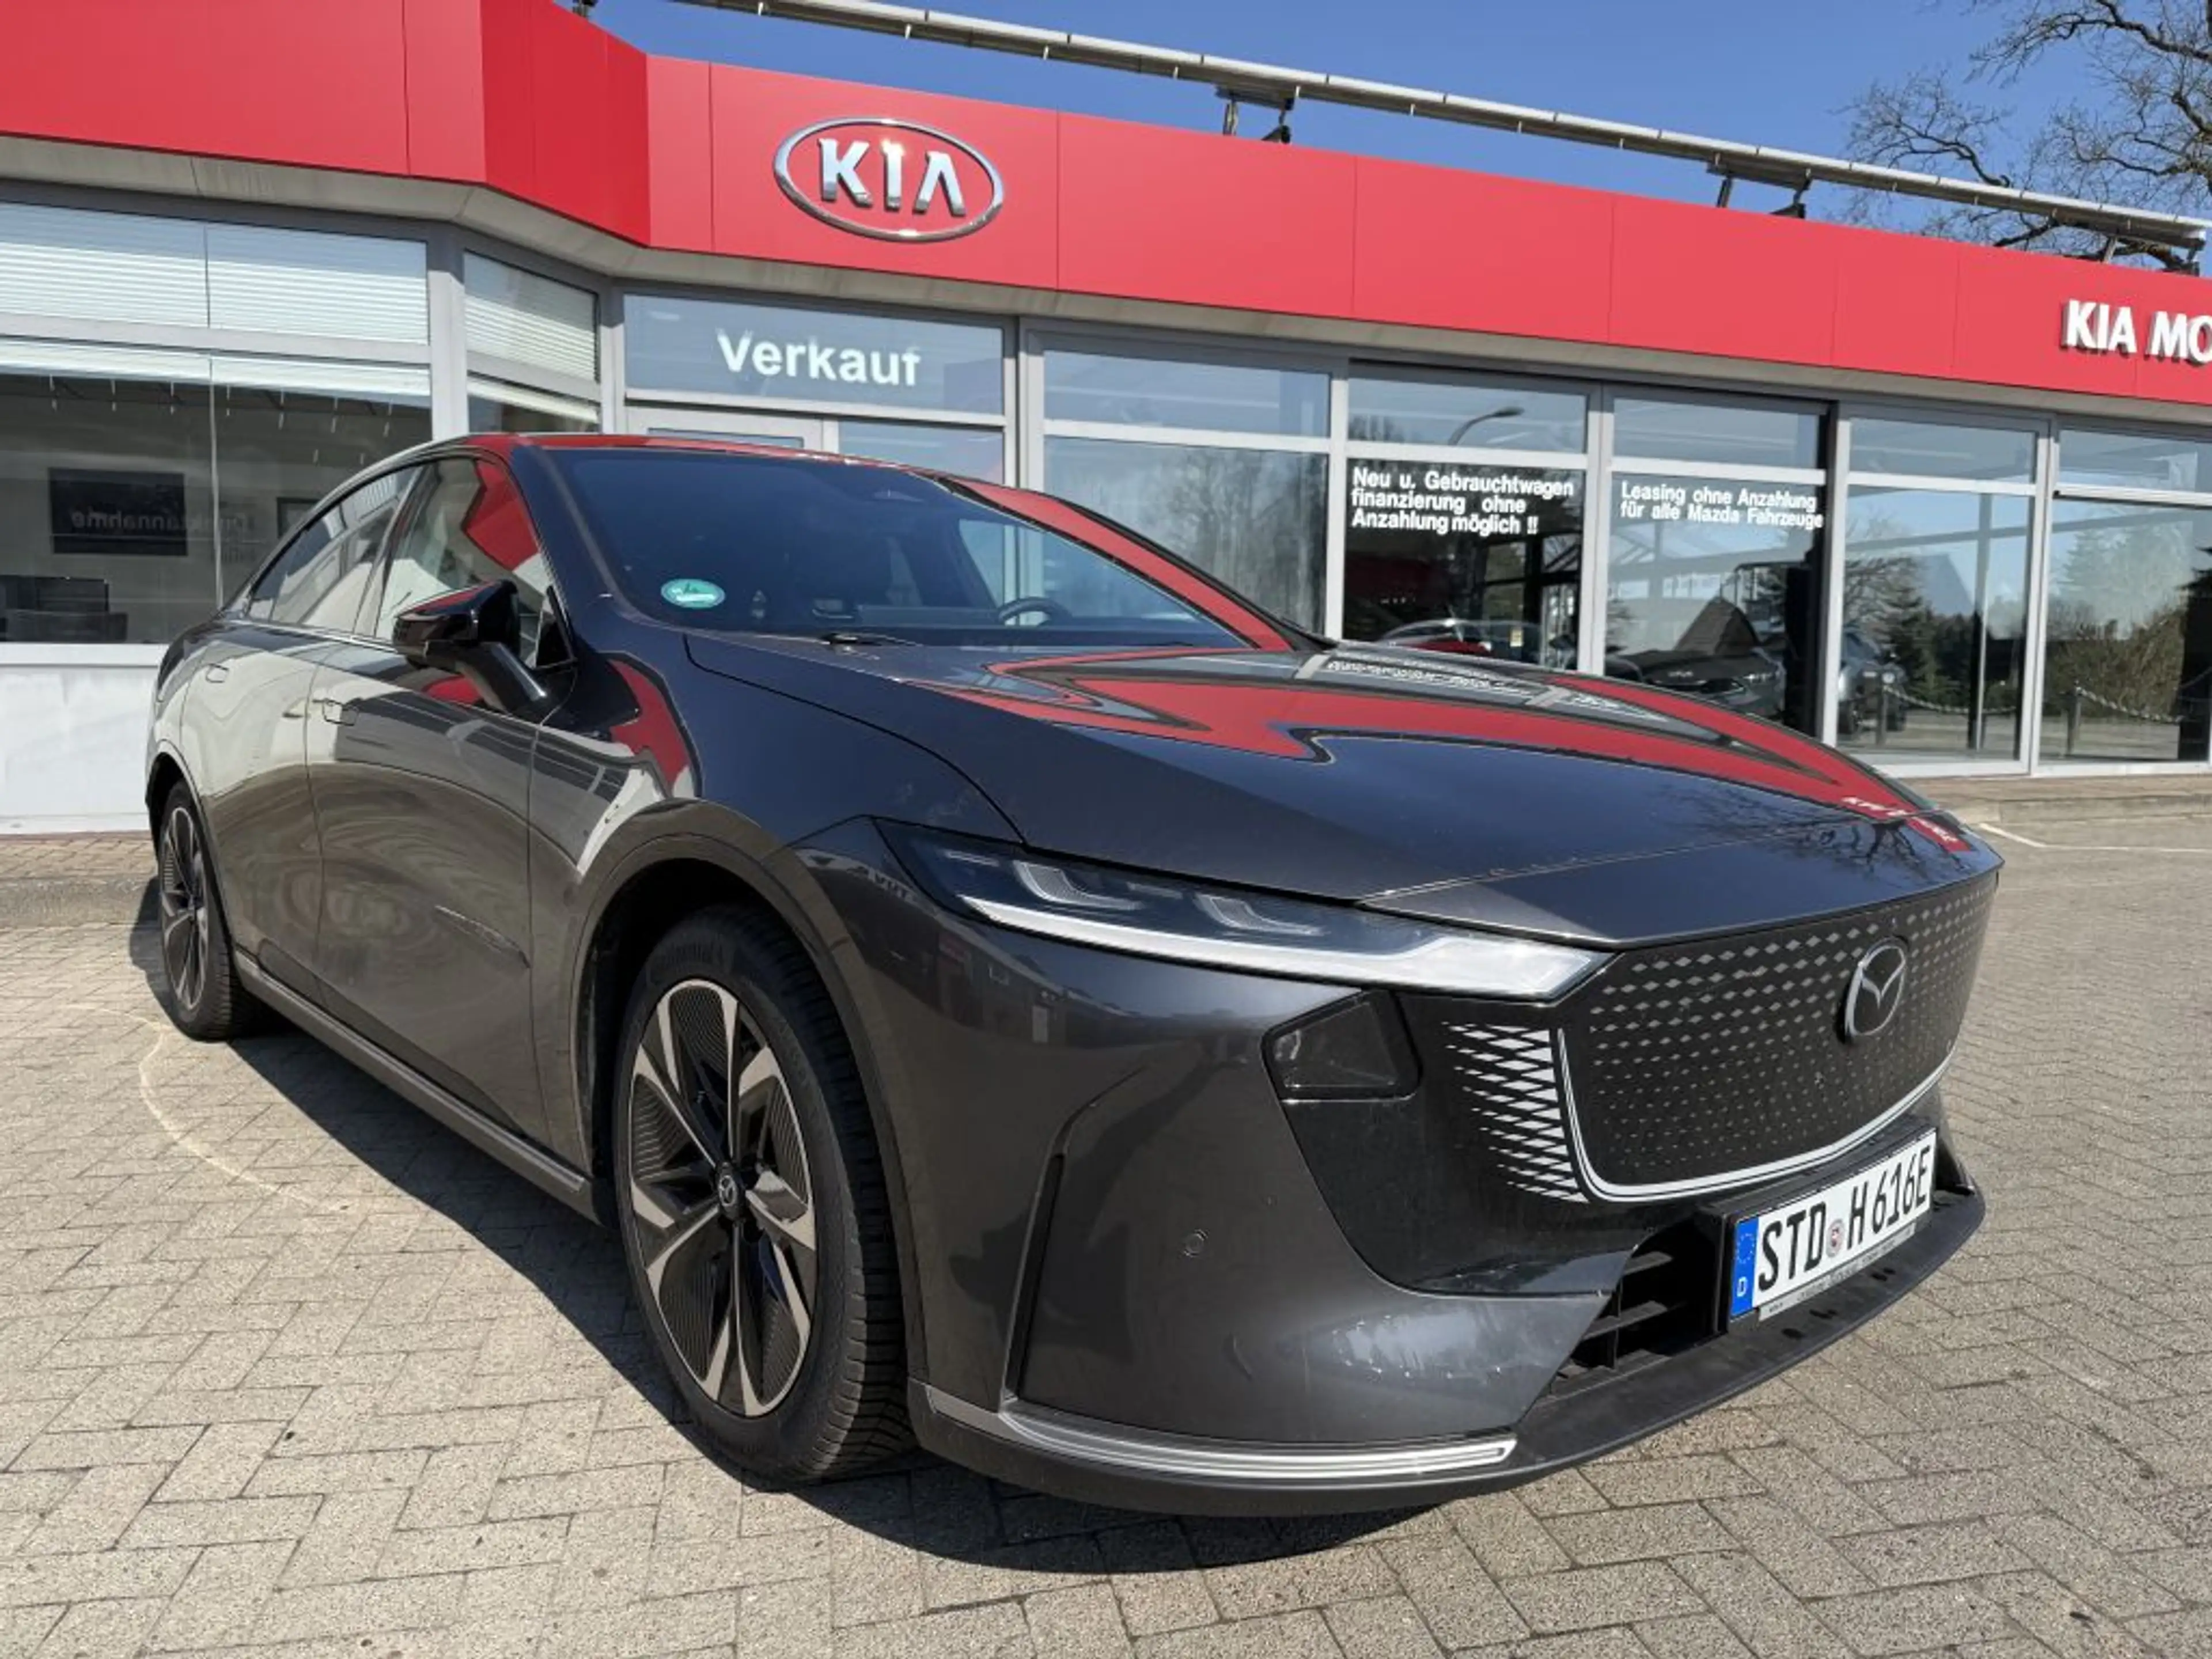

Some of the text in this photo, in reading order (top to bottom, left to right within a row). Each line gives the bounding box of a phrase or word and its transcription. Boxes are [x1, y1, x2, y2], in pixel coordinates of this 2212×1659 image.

[818, 138, 967, 216] KIA
[2062, 297, 2212, 364] KIA MO
[715, 327, 921, 385] Verkauf
[1352, 467, 1574, 499] Neu u. Gebrauchtwagen
[1621, 480, 1817, 513] Leasing ohne Anzahlung
[1351, 488, 1527, 514] finanzierung ohne
[1620, 501, 1824, 530] für alle Mazda Fahrzeuge
[1351, 508, 1539, 537] Anzahlung möglich !!
[1758, 1201, 1827, 1291] STD
